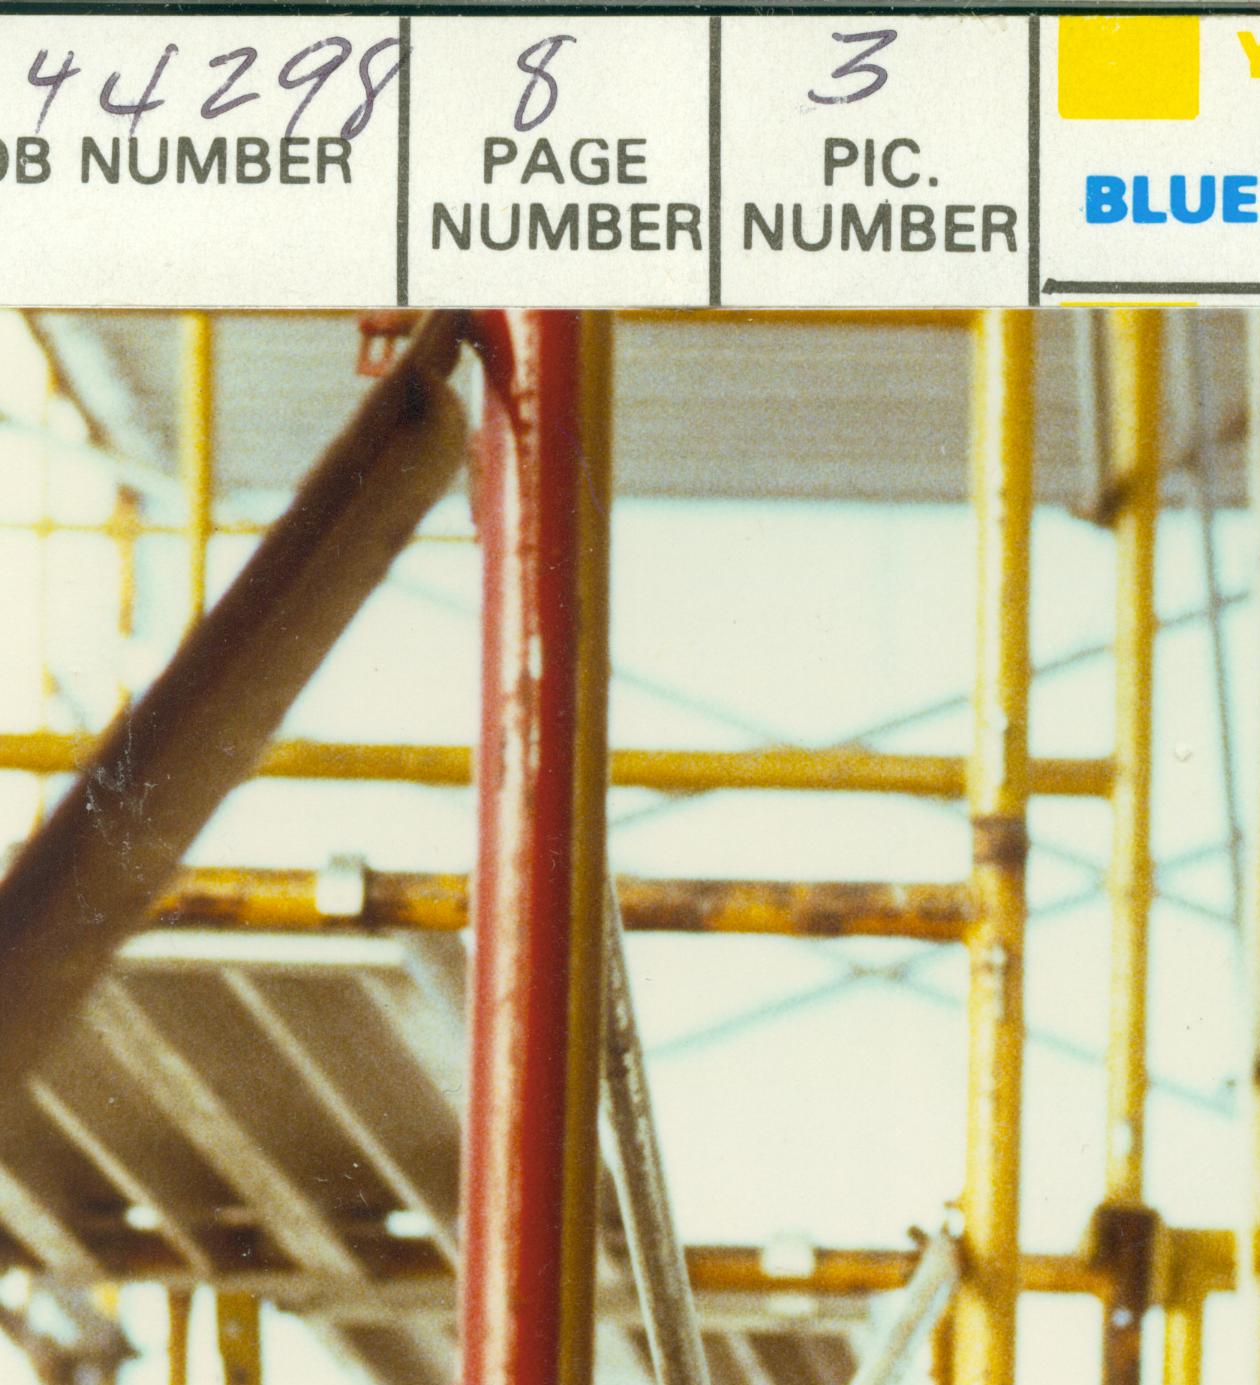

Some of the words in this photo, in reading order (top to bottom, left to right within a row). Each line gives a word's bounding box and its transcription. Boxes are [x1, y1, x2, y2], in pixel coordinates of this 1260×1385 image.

[27, 35, 411, 140] 44298
[514, 34, 577, 132] 8
[807, 29, 898, 105] 3
[0, 136, 52, 184] B
[81, 136, 353, 185] NUMBER
[483, 137, 648, 186] PAGE
[824, 137, 939, 188] PIC.
[1084, 174, 1259, 224] BLUE
[431, 203, 703, 252] NUMBER
[743, 203, 1018, 253] NUMBER
